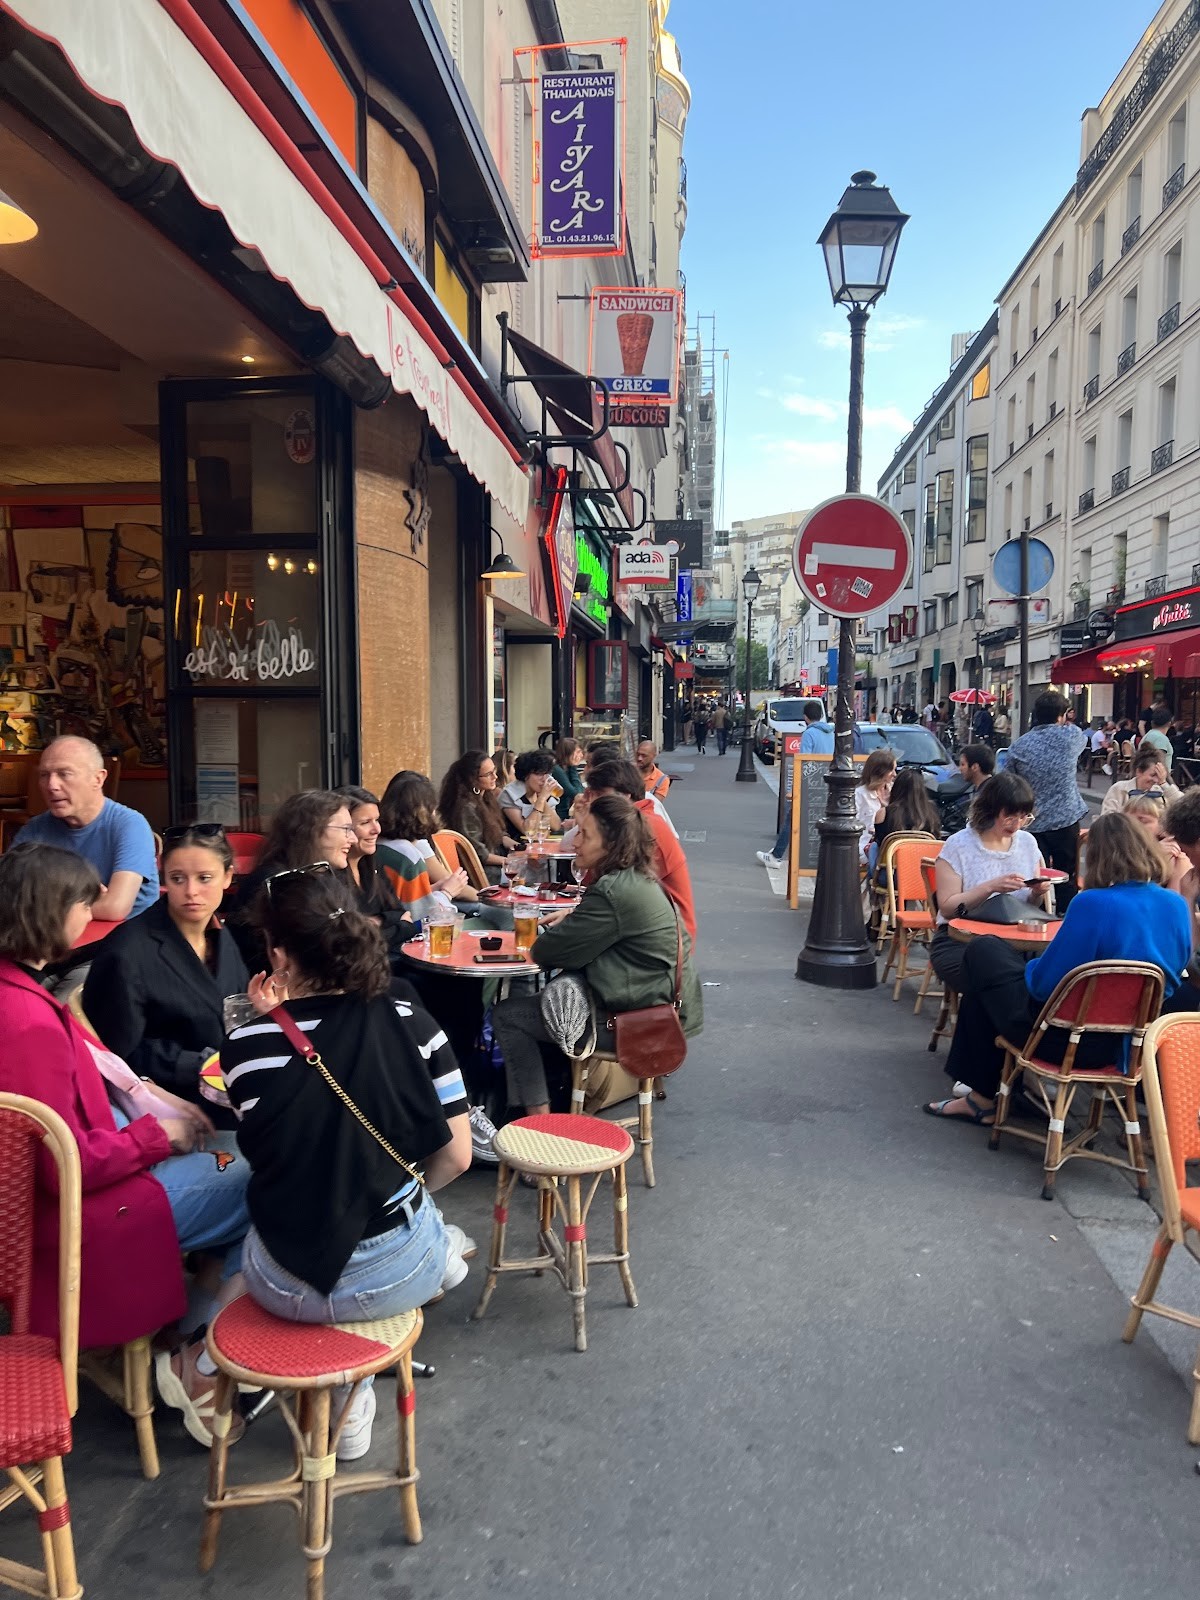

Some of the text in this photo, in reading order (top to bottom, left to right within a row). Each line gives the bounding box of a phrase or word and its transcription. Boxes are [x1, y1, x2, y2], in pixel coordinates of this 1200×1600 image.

[543, 76, 615, 88] RESTAURANT
[543, 87, 615, 99] THAILANDAIS
[550, 101, 605, 233] AIYARA
[556, 234, 615, 242] 01.43.21.96.12
[601, 298, 671, 310] SANDWICH
[612, 379, 653, 391] GREC
[625, 551, 651, 563] ada
[679, 577, 689, 644] TIMHOL
[182, 640, 218, 677] est
[257, 634, 315, 681] belle
